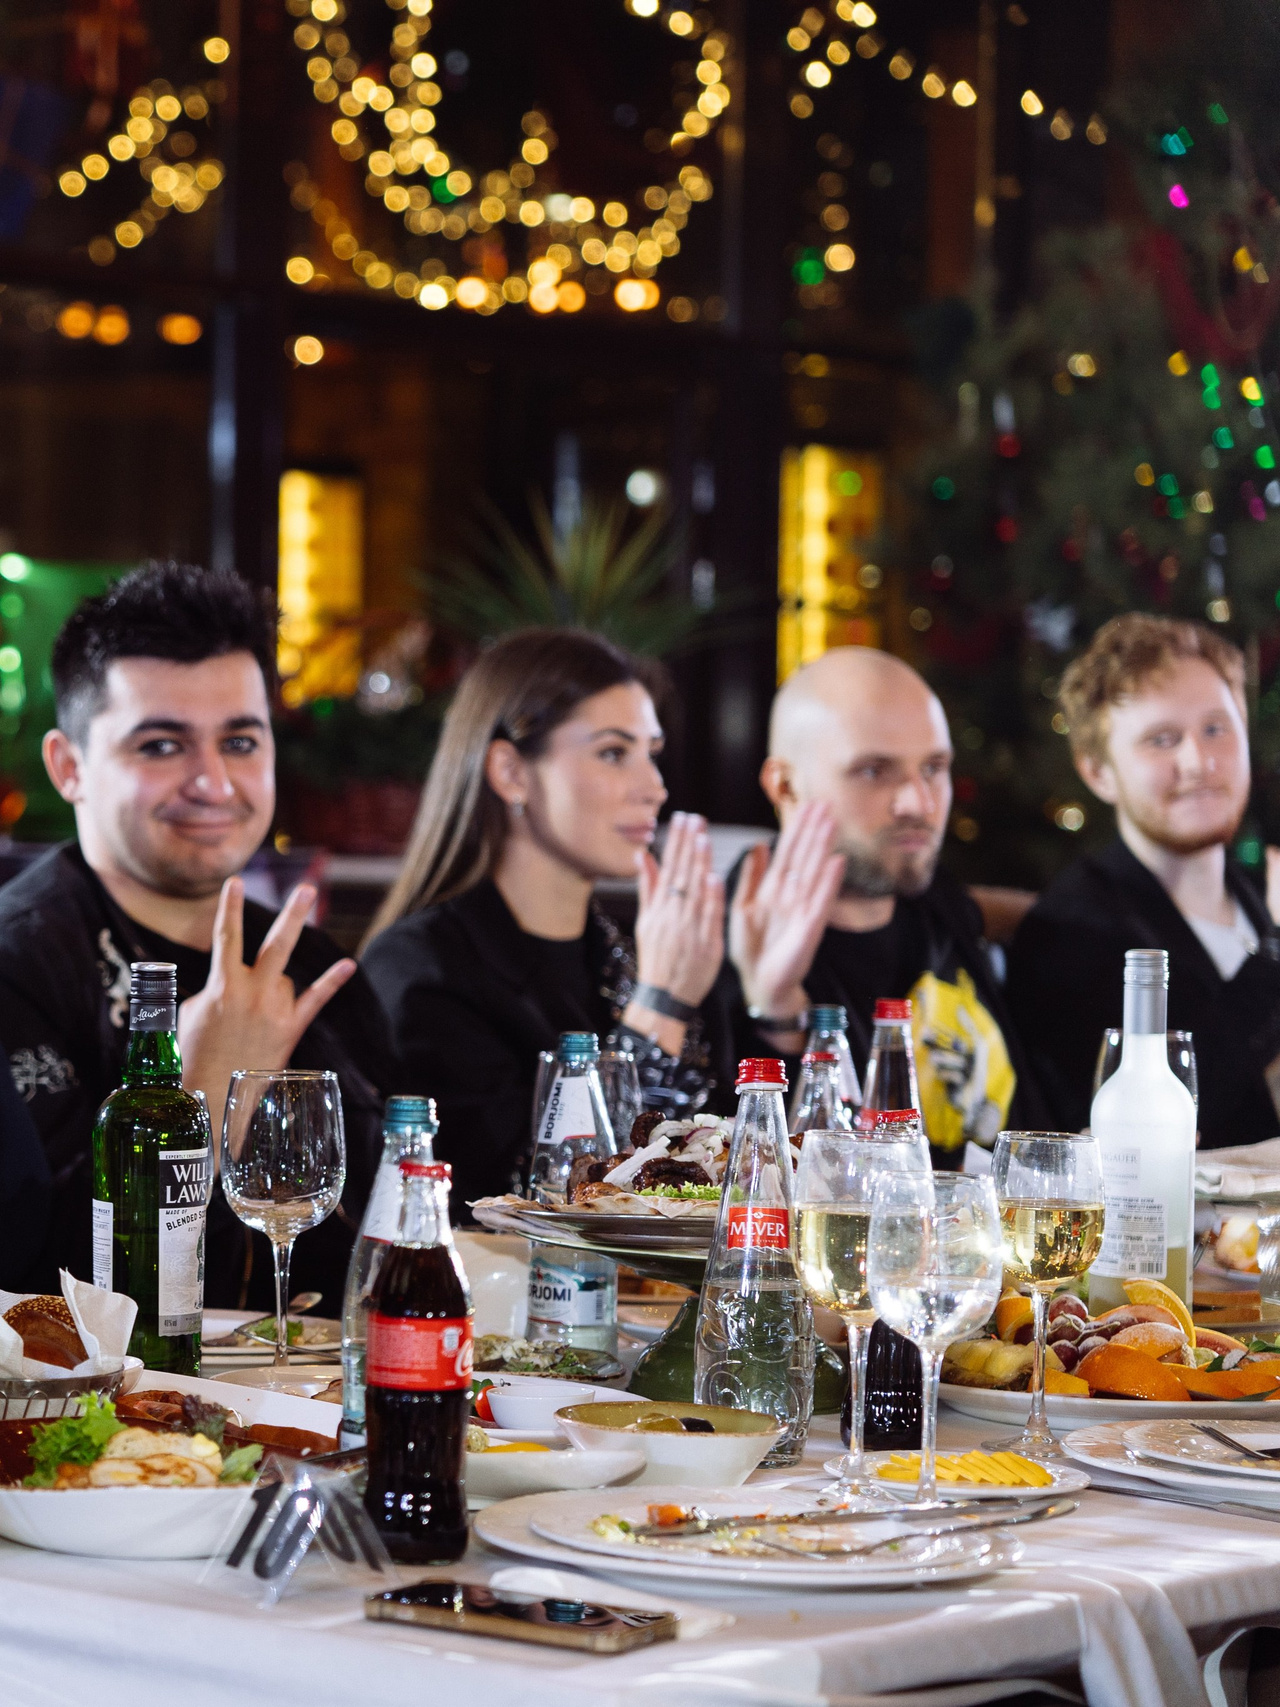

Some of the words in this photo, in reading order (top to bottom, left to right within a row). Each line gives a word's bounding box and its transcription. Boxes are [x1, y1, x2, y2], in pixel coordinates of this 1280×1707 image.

[543, 1081, 564, 1140] BORJOMI
[165, 1212, 198, 1231] BLENDED
[730, 1221, 787, 1238] MEVER
